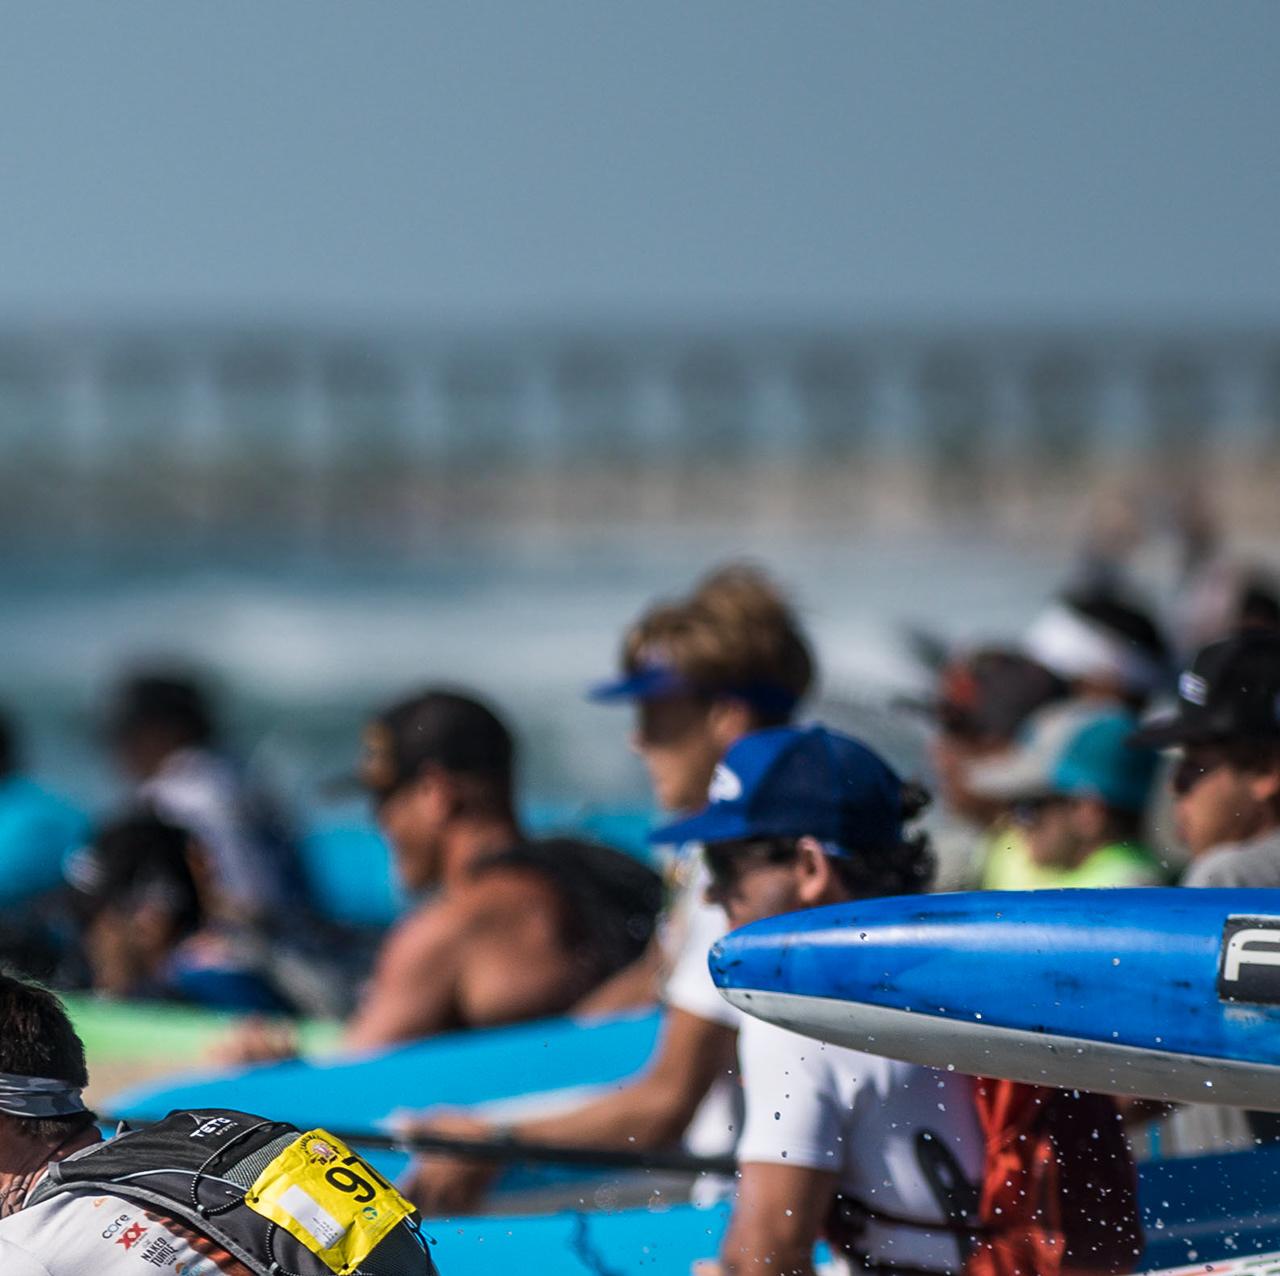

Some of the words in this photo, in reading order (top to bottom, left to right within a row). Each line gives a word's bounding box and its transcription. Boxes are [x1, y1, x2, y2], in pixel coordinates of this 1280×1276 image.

[324, 1155, 391, 1204] 97
[102, 1214, 130, 1239] core
[140, 1237, 167, 1261] NAKED
[149, 1244, 179, 1268] TURTLE
